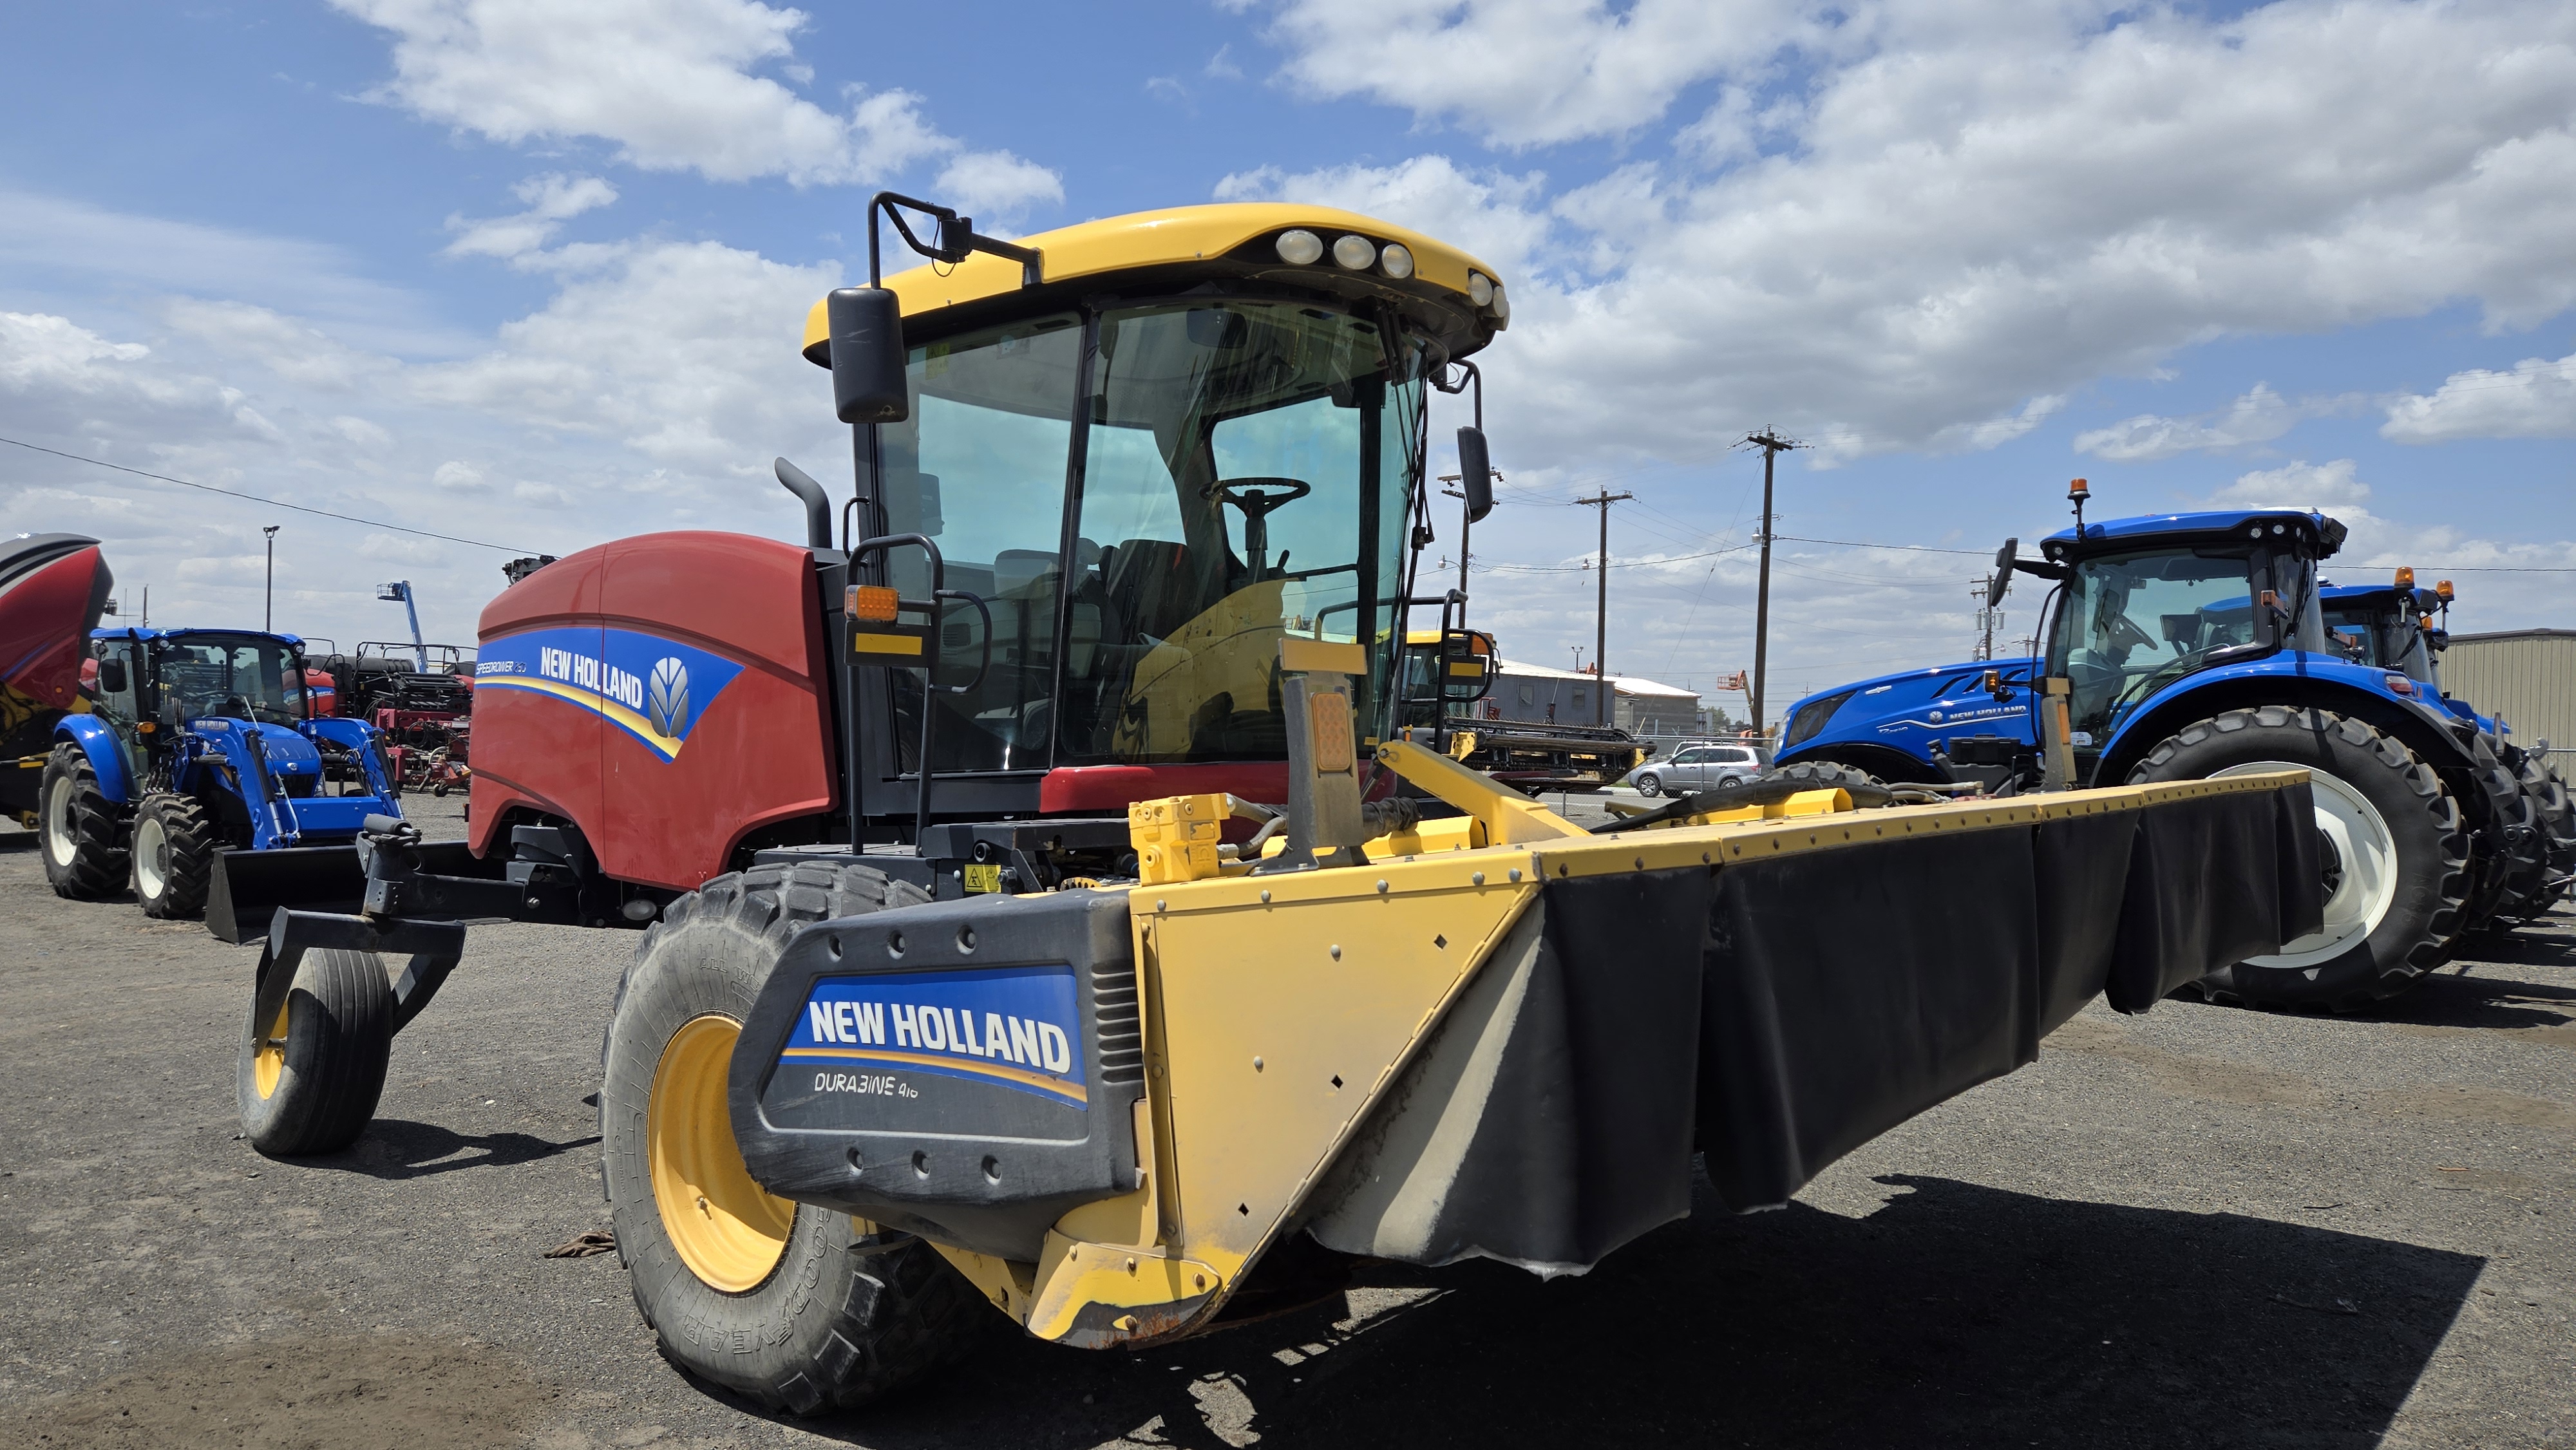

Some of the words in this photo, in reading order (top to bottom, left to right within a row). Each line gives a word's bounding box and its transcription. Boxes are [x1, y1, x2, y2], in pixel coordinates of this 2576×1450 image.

[476, 661, 513, 674] SPEEDROWER
[541, 646, 571, 681] NEW
[574, 654, 643, 710] HOLLAND
[1949, 710, 1974, 721] NEW
[1976, 705, 2027, 717] HOLLAND
[195, 720, 206, 729] NEW
[207, 720, 229, 731] HOLLAND
[809, 1001, 885, 1045] NEW
[891, 1004, 1071, 1074] HOLLAND
